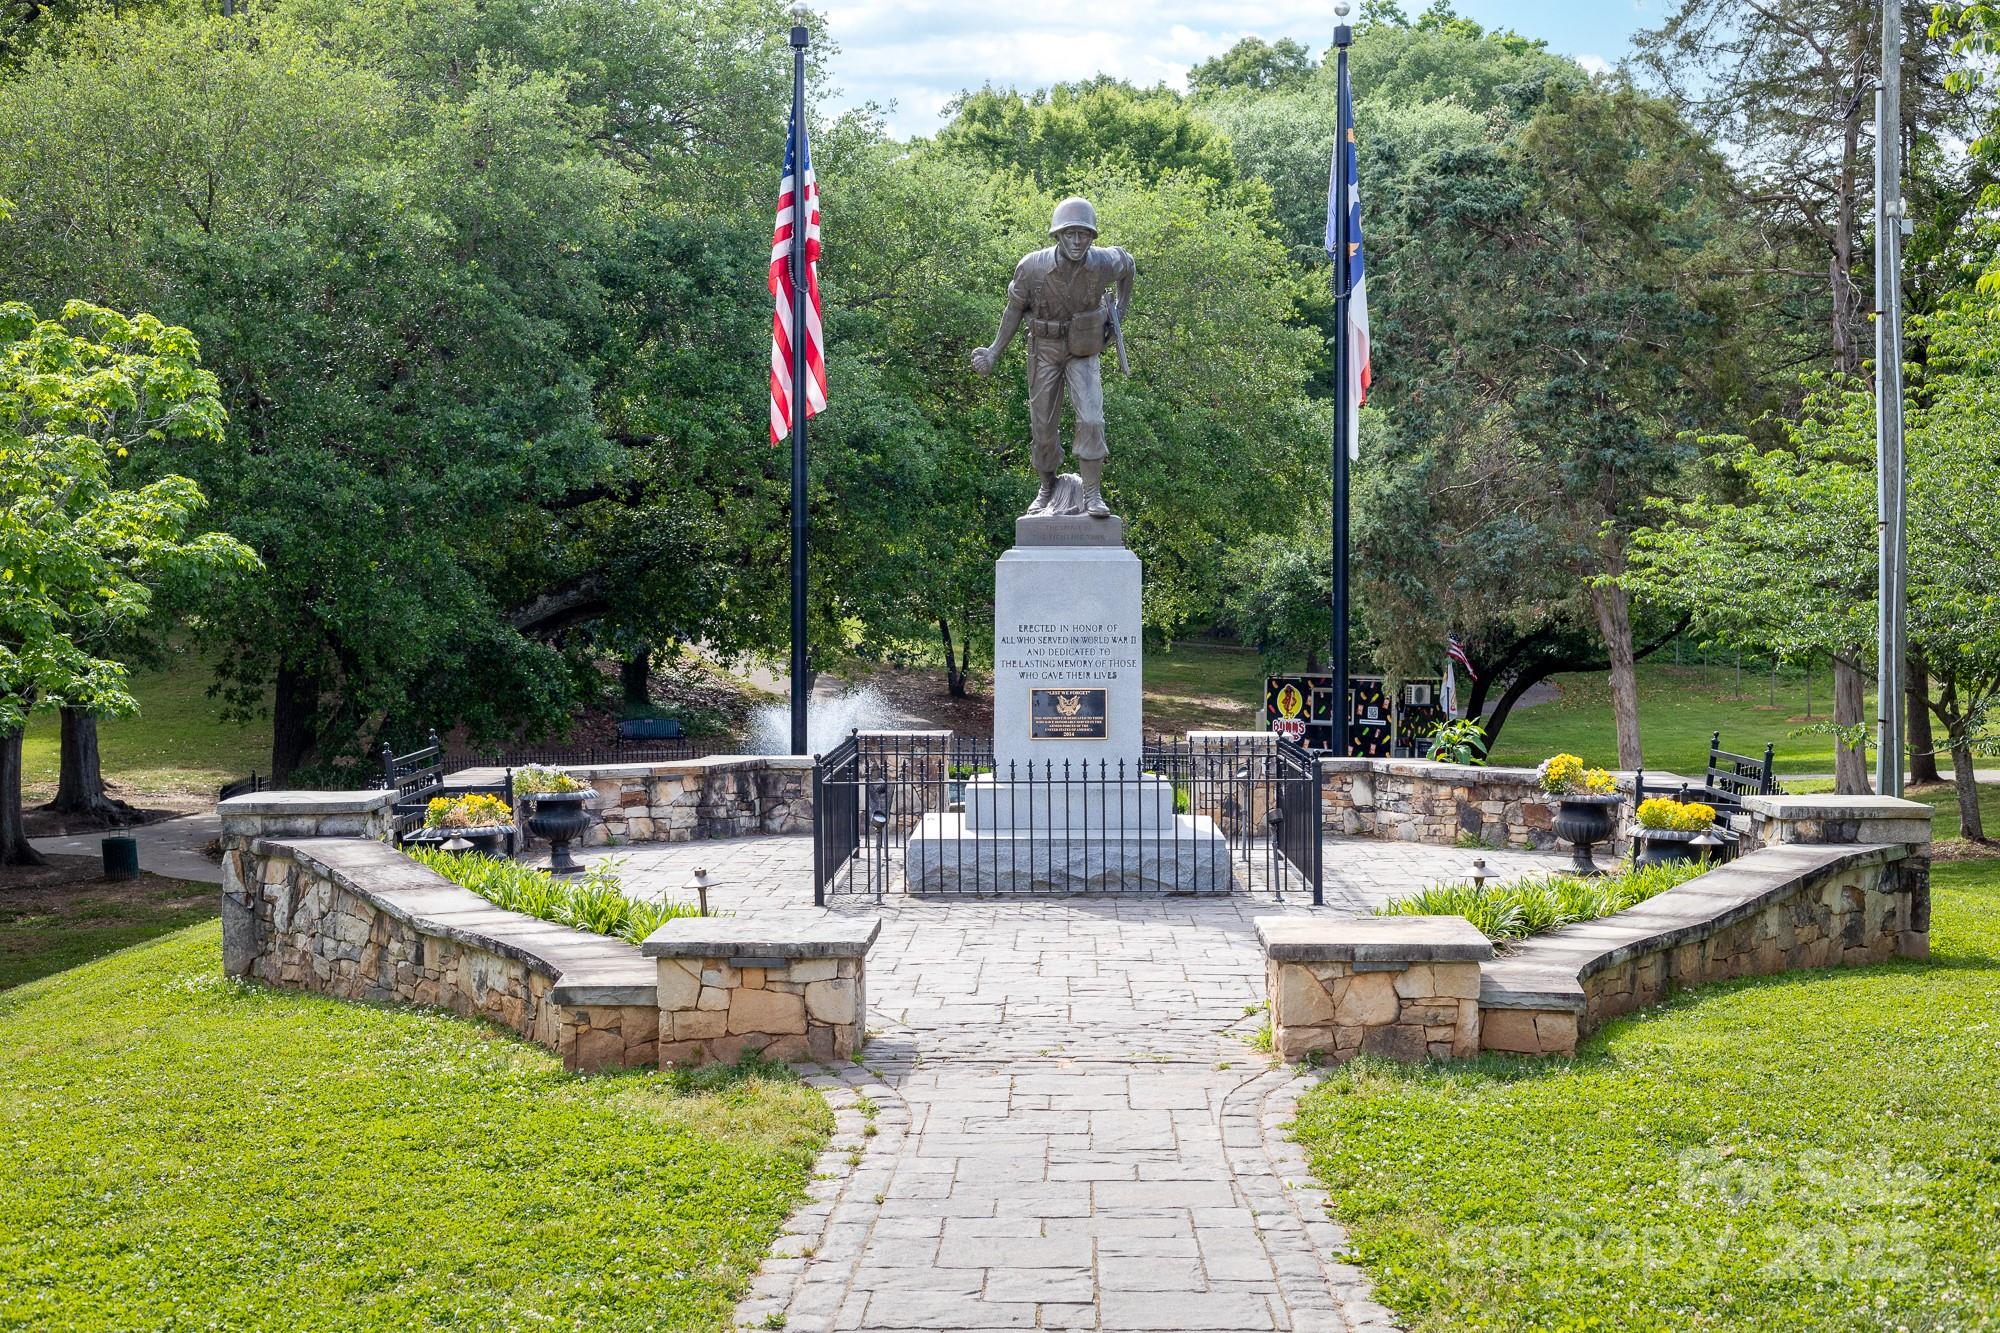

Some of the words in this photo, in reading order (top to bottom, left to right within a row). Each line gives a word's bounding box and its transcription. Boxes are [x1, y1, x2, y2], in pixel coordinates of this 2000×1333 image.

[1018, 624, 1056, 633] ERECTED
[1060, 624, 1069, 633] IN
[1072, 624, 1103, 633] HONOR
[1106, 624, 1118, 633] OF
[1000, 636, 1015, 645] ALL
[1016, 636, 1036, 645] WHO
[1037, 636, 1069, 645] SERVED
[1070, 636, 1080, 645] IN
[1081, 636, 1110, 645] WORLD
[1111, 636, 1128, 645] WAR
[1130, 636, 1137, 645] II
[1026, 648, 1045, 656] AND
[1048, 648, 1096, 656] DEDICATED
[1099, 648, 1111, 656] TO
[1001, 660, 1018, 668] THE
[1018, 660, 1055, 668] LASTING
[1057, 660, 1094, 668] MEMORY
[1095, 660, 1106, 668] OF
[1108, 660, 1137, 668] THOSE
[1018, 671, 1039, 680] WHO
[1041, 671, 1064, 680] GAVE
[1067, 671, 1091, 680] THEIR
[1094, 671, 1118, 680] LIVES
